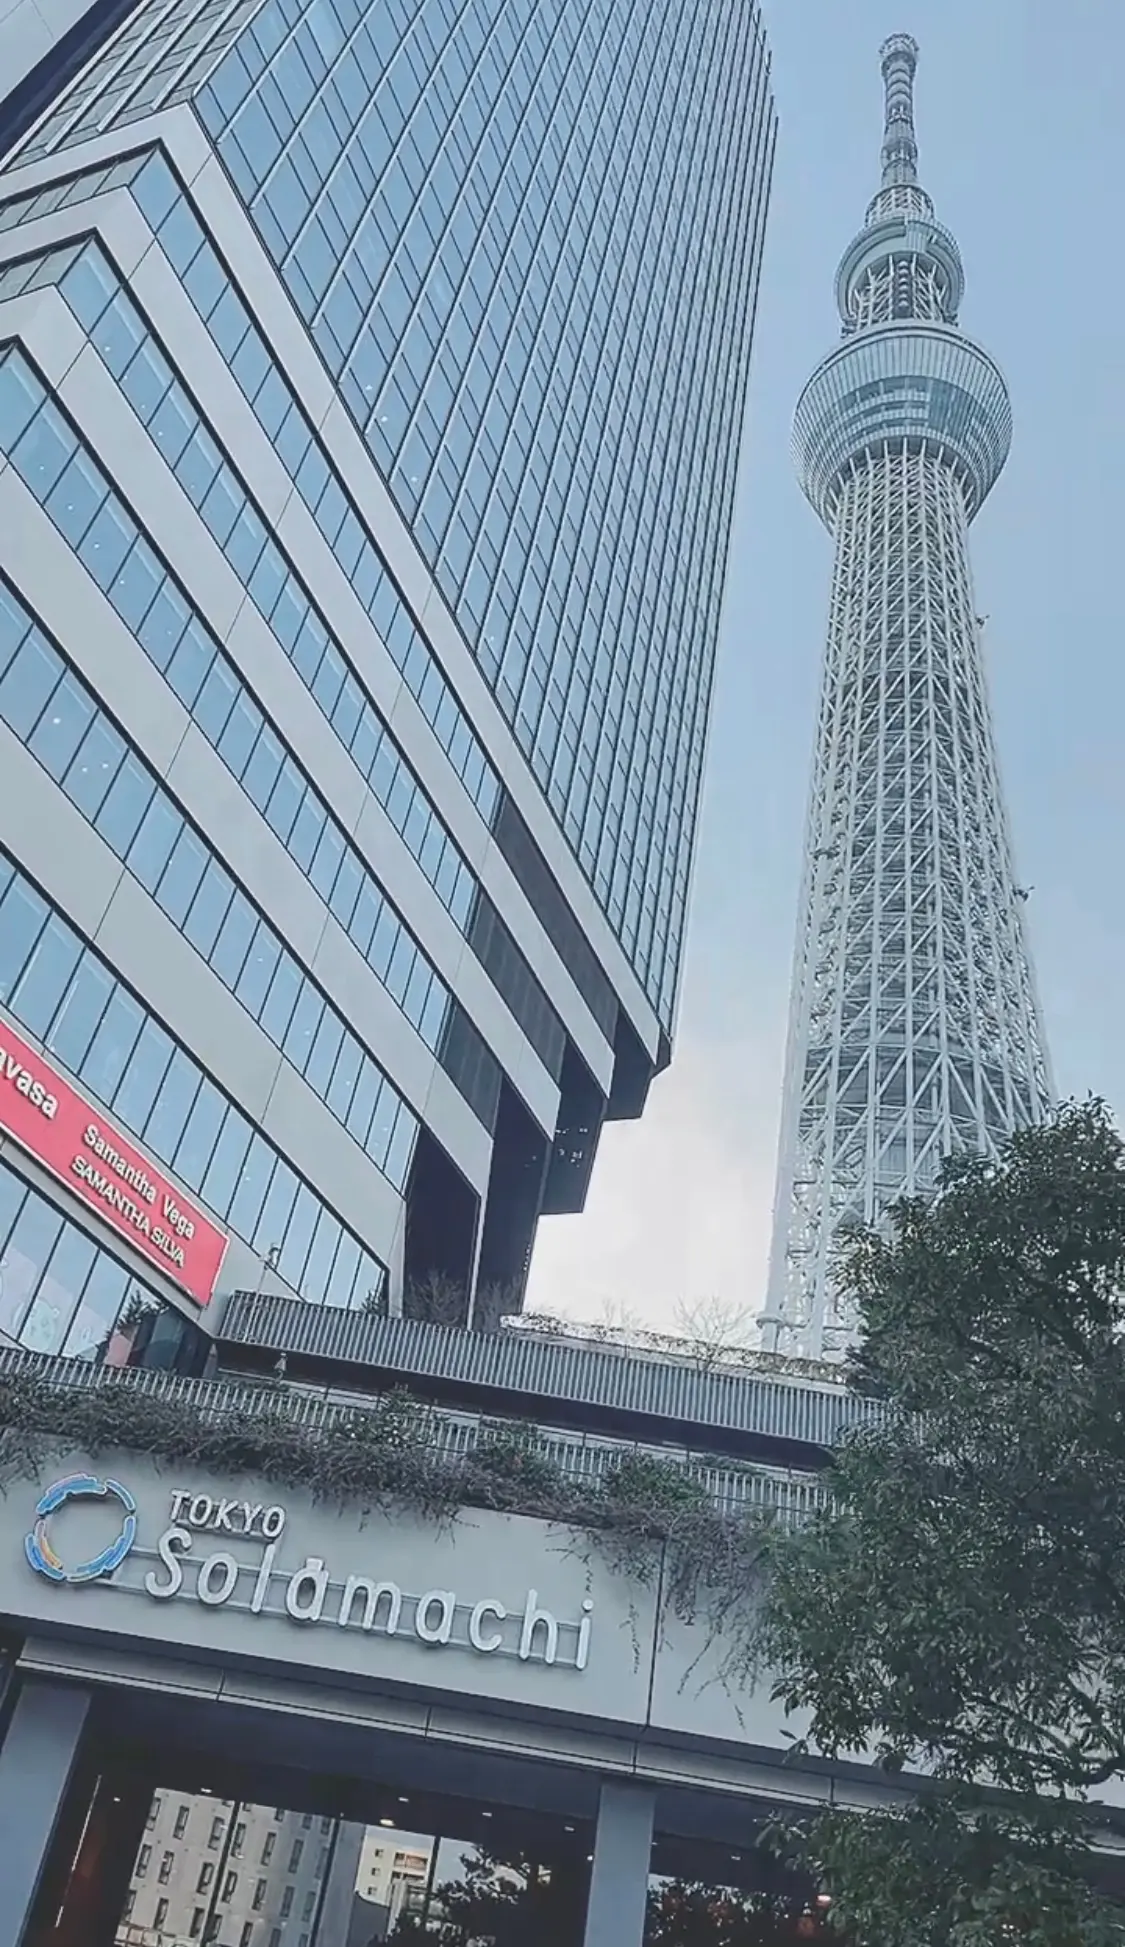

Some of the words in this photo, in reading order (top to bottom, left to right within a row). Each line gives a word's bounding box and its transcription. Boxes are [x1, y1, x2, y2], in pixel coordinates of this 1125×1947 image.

[71, 1155, 151, 1237] SAMANTHA
[150, 1226, 185, 1268] SILVA
[83, 1123, 157, 1203] Samantha
[162, 1194, 196, 1240] Vega
[170, 1488, 286, 1538] TOKYO
[145, 1528, 595, 1671] Solamachi
